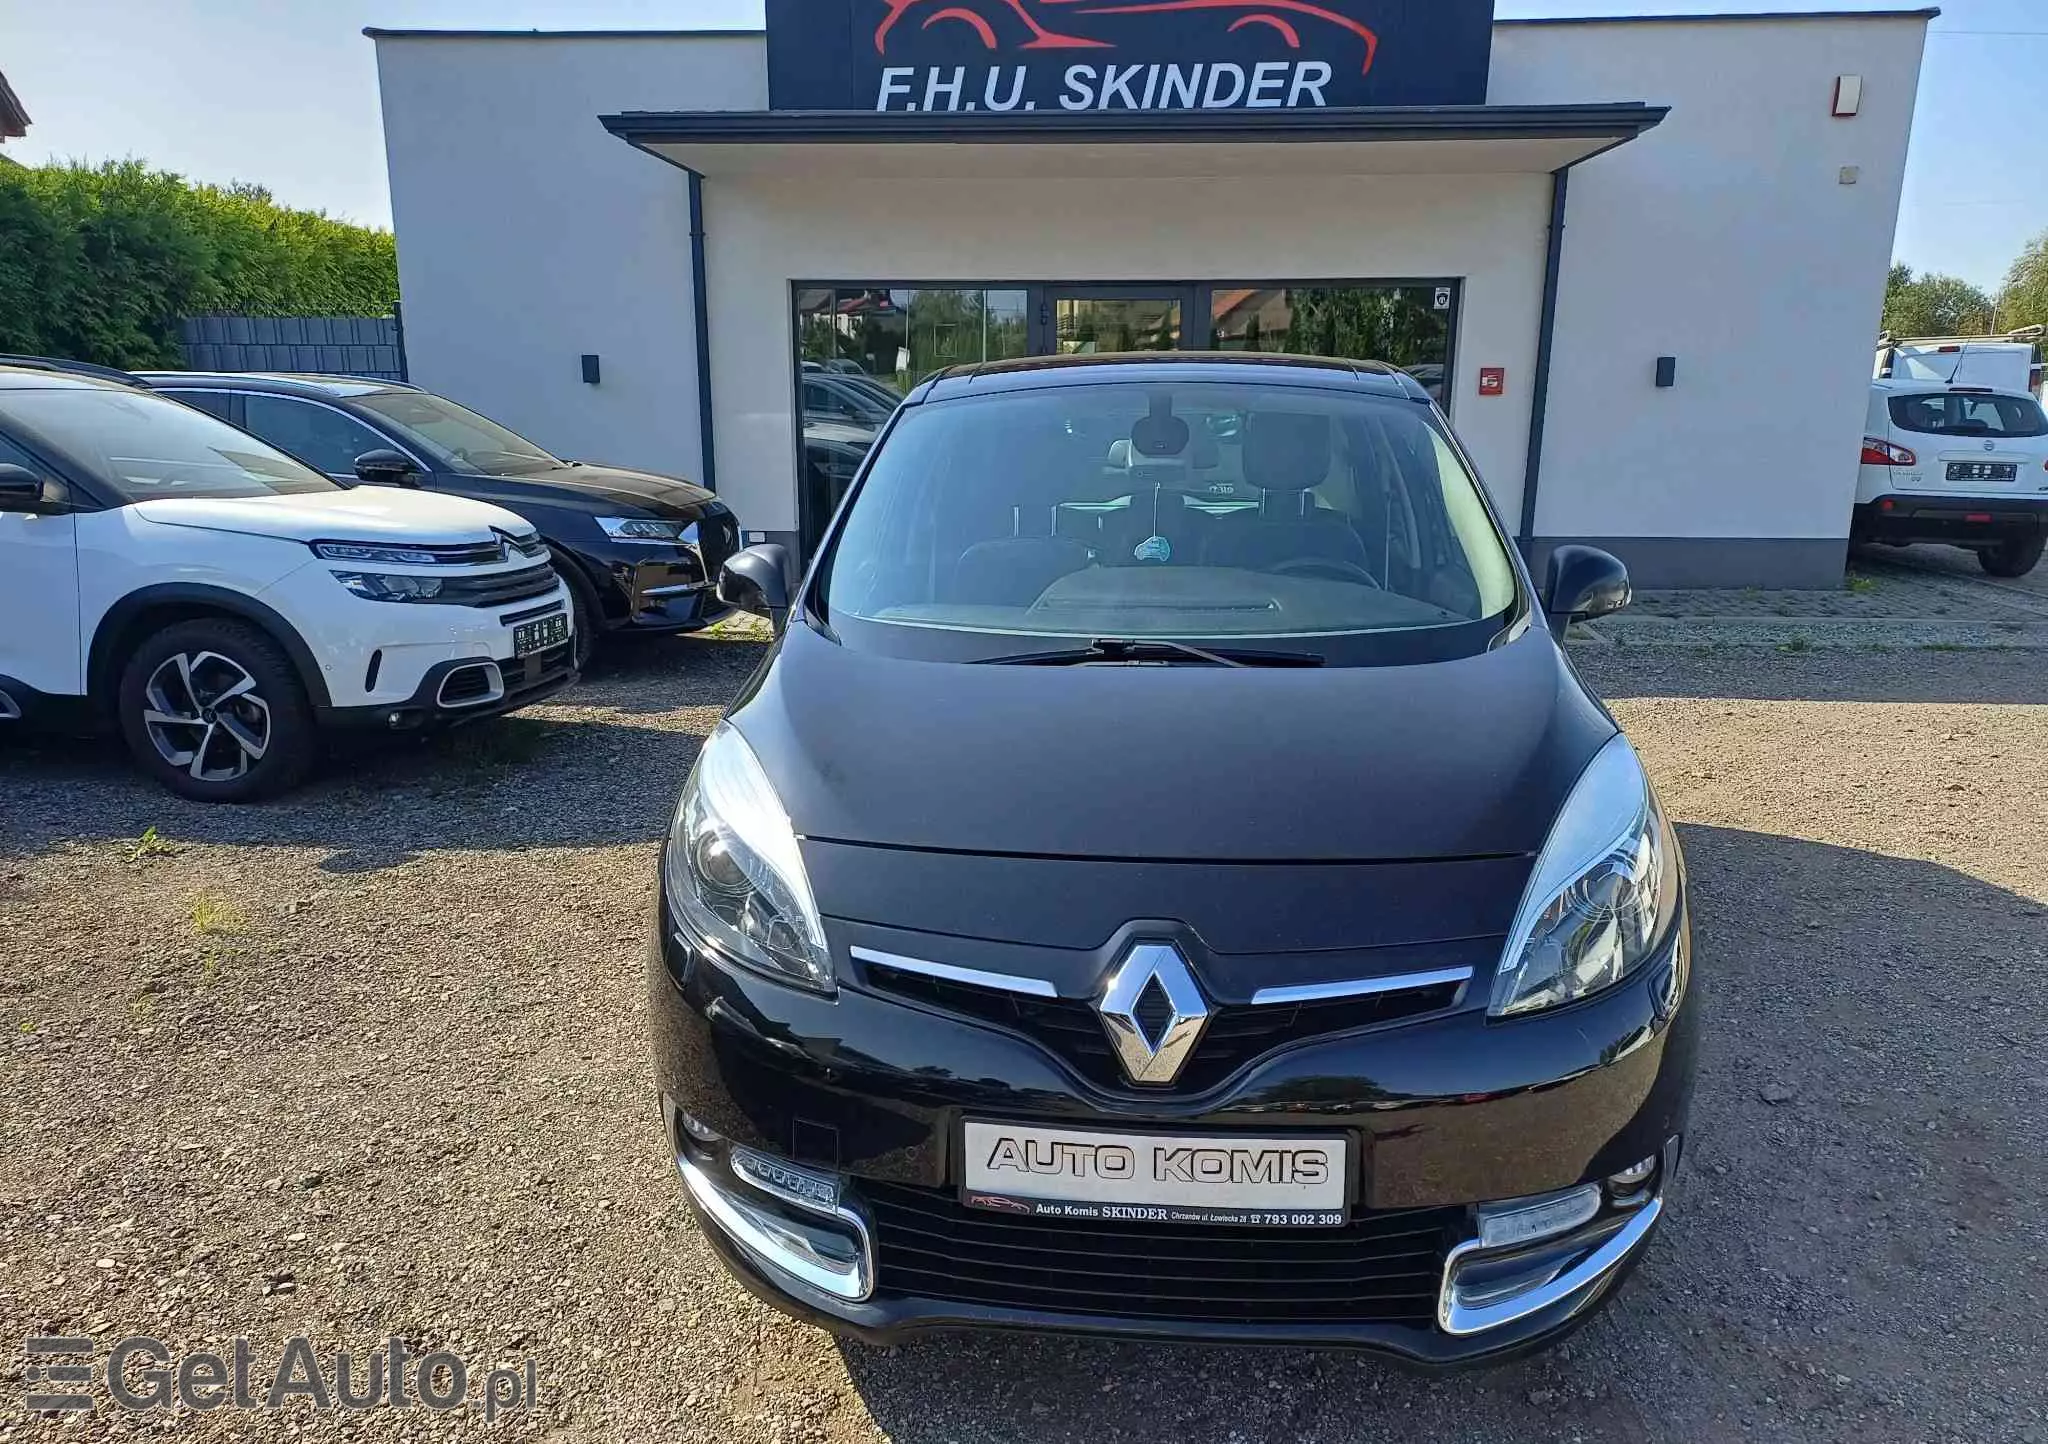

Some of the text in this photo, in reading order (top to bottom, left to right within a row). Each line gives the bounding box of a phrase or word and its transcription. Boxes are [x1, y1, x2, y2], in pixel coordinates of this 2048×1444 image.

[876, 61, 1332, 112] F.H.U. SKINDER
[987, 1138, 1329, 1184] AUTO KOMIS
[1035, 1203, 1061, 1215] Auto
[1064, 1205, 1099, 1217] Komis
[1102, 1206, 1168, 1220] SKINDER
[1264, 1214, 1288, 1225] 793
[1291, 1214, 1315, 1225] 002
[1318, 1214, 1342, 1225] 309
